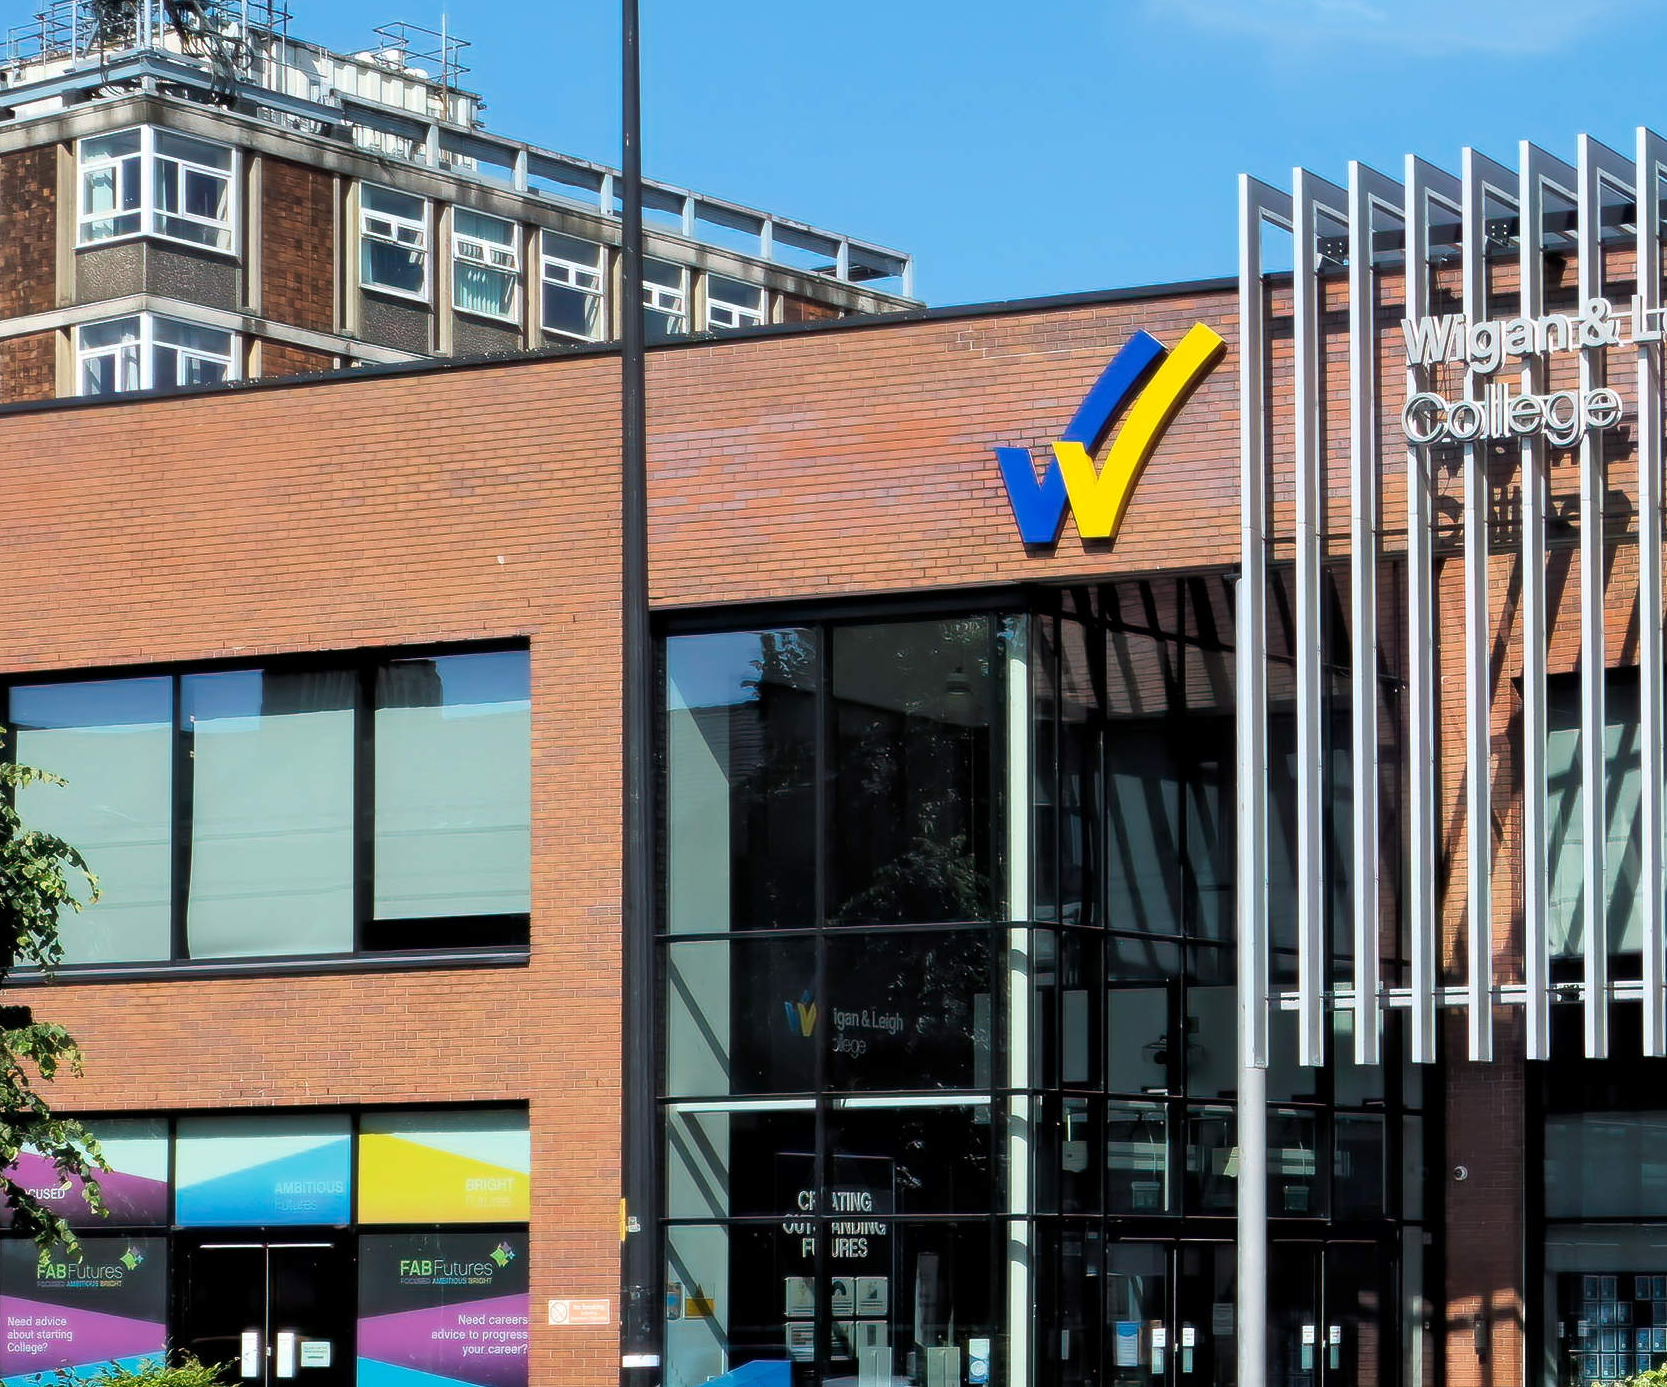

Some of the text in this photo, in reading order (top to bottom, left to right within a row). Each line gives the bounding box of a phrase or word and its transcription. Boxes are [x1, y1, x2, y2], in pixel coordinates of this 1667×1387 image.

[1401, 312, 1572, 374] Wigan
[1581, 298, 1621, 347] &
[1402, 382, 1623, 449] College
[833, 1008, 904, 1035] igan & Leigh
[275, 1180, 344, 1194] AMBITIOUS
[465, 1178, 514, 1192] BRIGHT
[37, 1263, 123, 1280] FAB Futures
[400, 1259, 493, 1276] FAB Futures
[432, 1277, 467, 1285] AMBITIOUS
[468, 1277, 492, 1285] BRIGHT
[7, 1316, 67, 1327] Need advice
[458, 1314, 528, 1325] Need careers
[7, 1329, 73, 1342] about starting
[432, 1328, 528, 1343] advice to progress
[7, 1342, 48, 1355] College?
[462, 1343, 528, 1357] your career?
